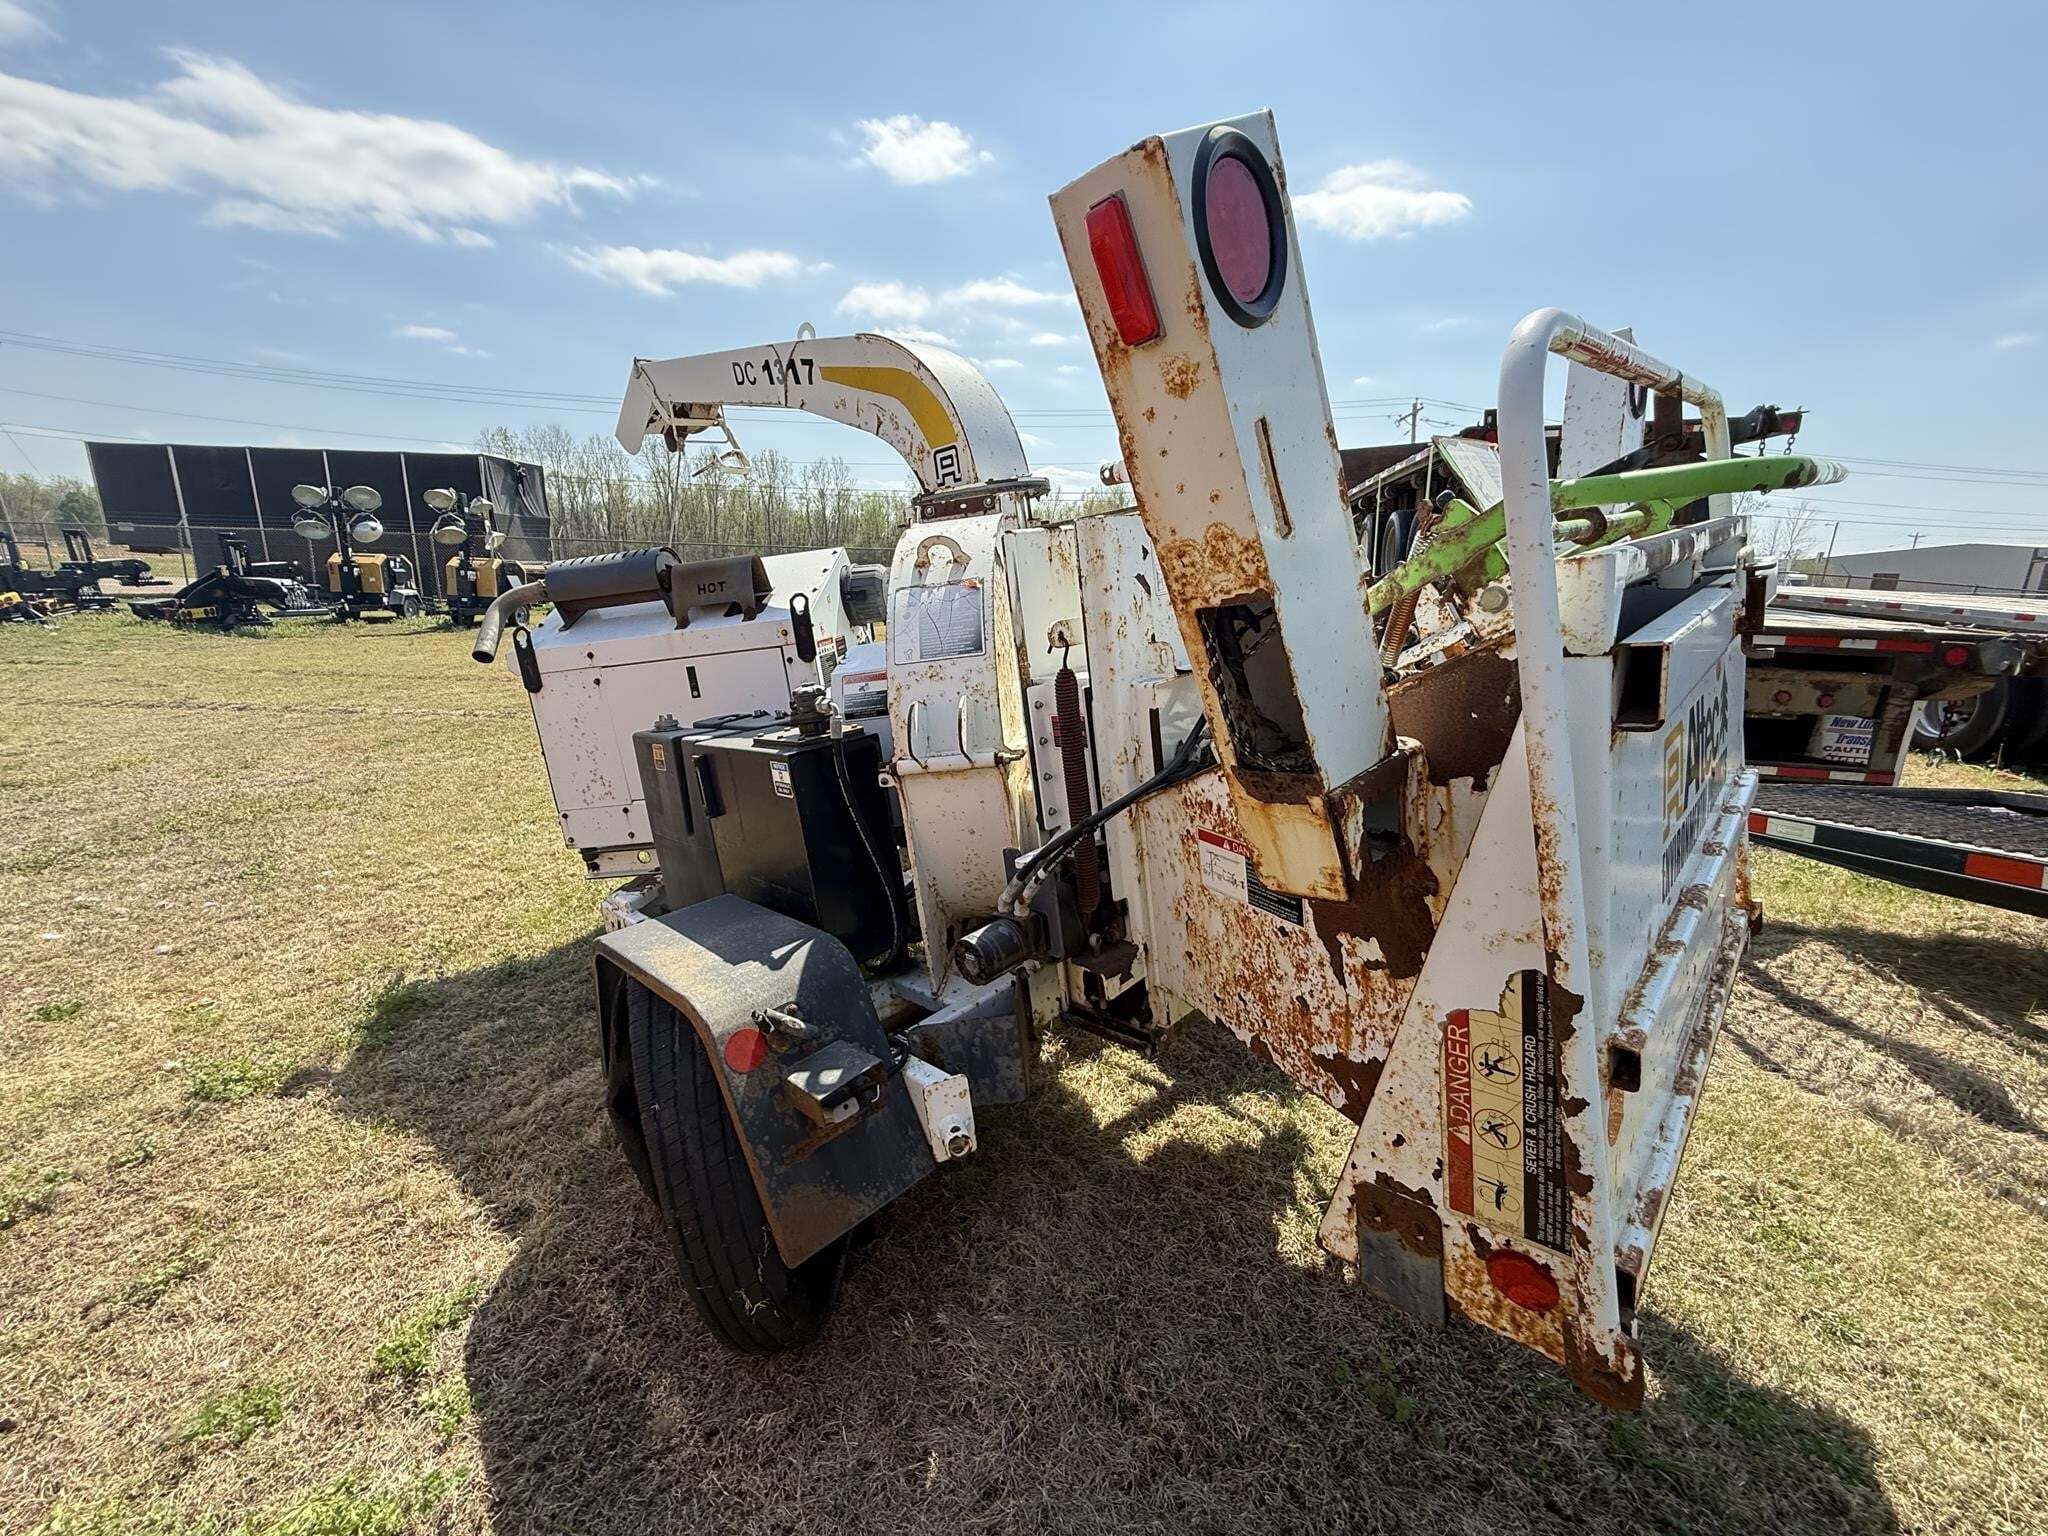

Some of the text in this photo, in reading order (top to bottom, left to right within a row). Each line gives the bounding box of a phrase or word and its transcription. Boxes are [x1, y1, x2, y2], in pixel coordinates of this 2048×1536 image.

[732, 361, 757, 386] DC
[697, 581, 727, 595] HOT
[1830, 716, 1859, 728] New
[1684, 694, 1720, 811] Altec
[1822, 745, 1871, 754] CAUTI
[1232, 842, 1251, 858] DAN
[1536, 986, 1544, 1004] listed
[1536, 1004, 1545, 1029] warnings
[1536, 1030, 1544, 1040] and
[1447, 1024, 1472, 1124] DANGER
[1536, 1074, 1544, 1082] all
[1537, 1083, 1545, 1100] follow
[1524, 1035, 1537, 1174] SEVER & CRUSH HAZARD
[1537, 1101, 1546, 1119] Always
